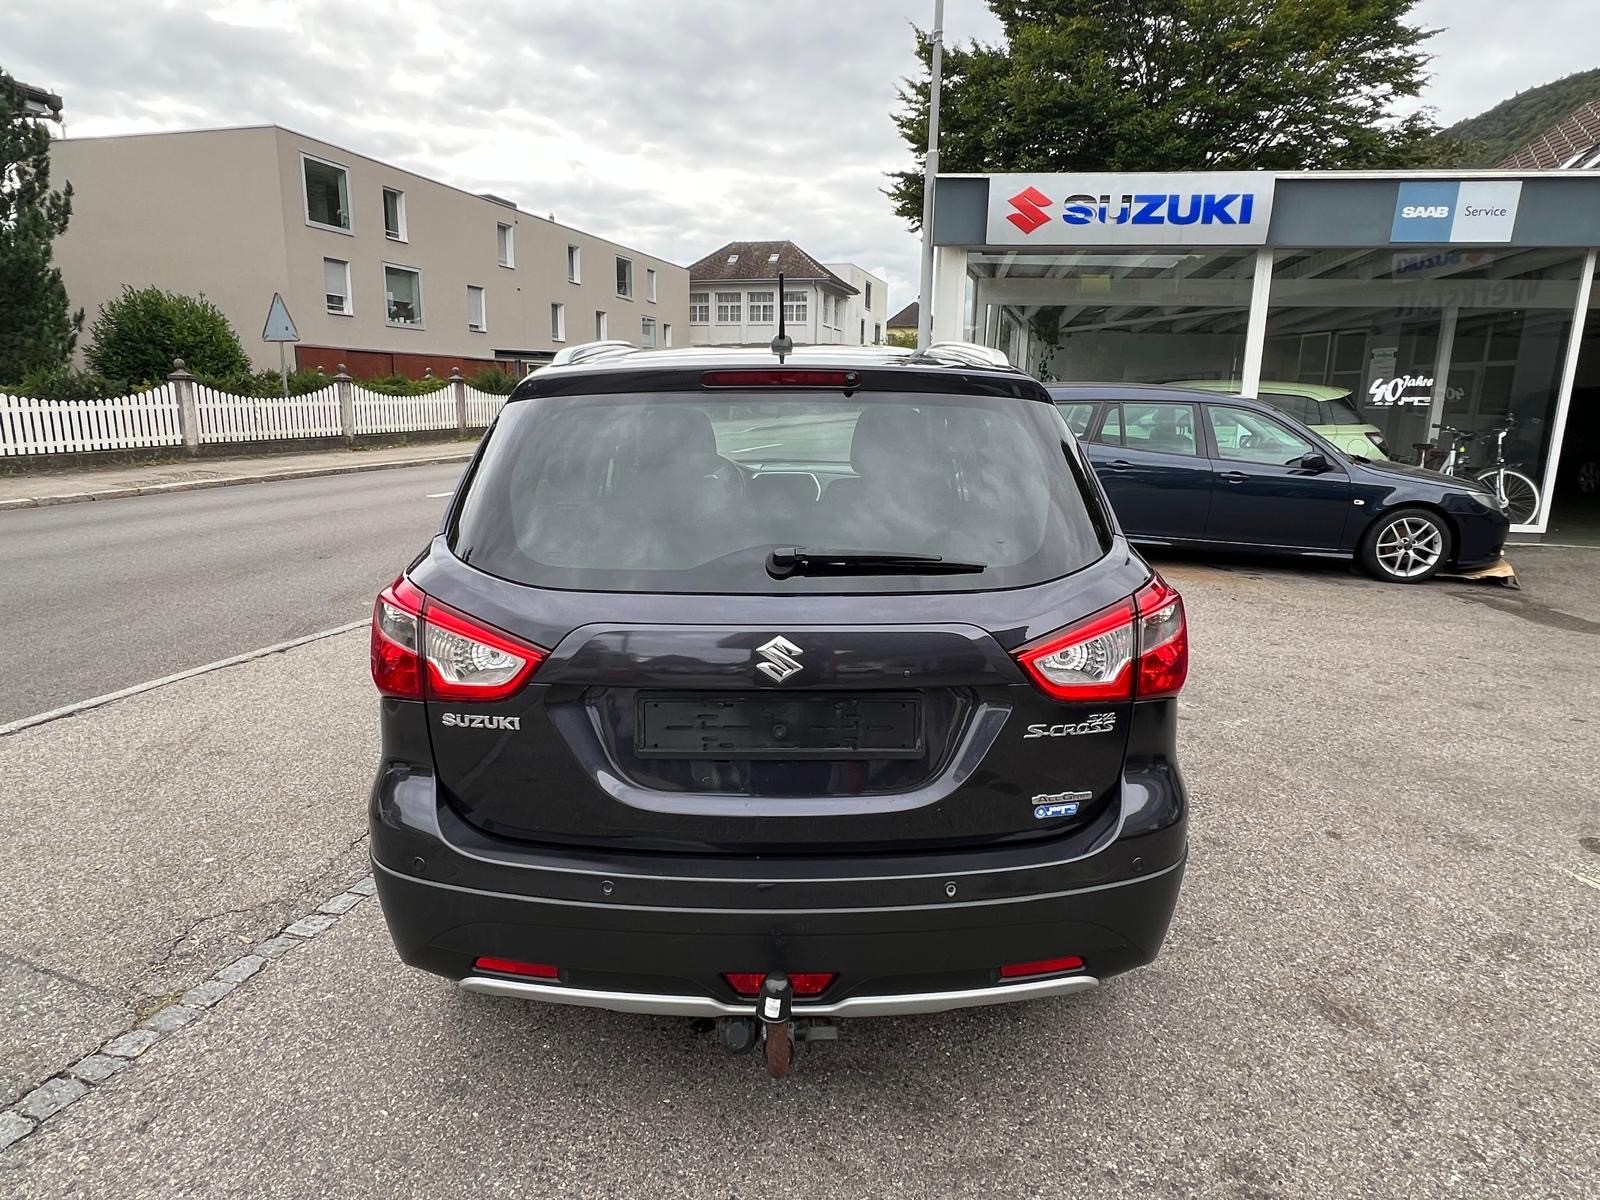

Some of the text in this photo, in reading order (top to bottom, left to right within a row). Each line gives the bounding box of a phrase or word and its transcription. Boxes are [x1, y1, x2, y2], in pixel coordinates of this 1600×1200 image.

[1062, 193, 1254, 225] SUZUKI
[1401, 206, 1507, 218] SAAB Service
[1369, 377, 1404, 402] 40
[1403, 375, 1434, 387] Jahre
[442, 712, 521, 730] SUZUKI
[1023, 720, 1116, 739] S-CROSS
